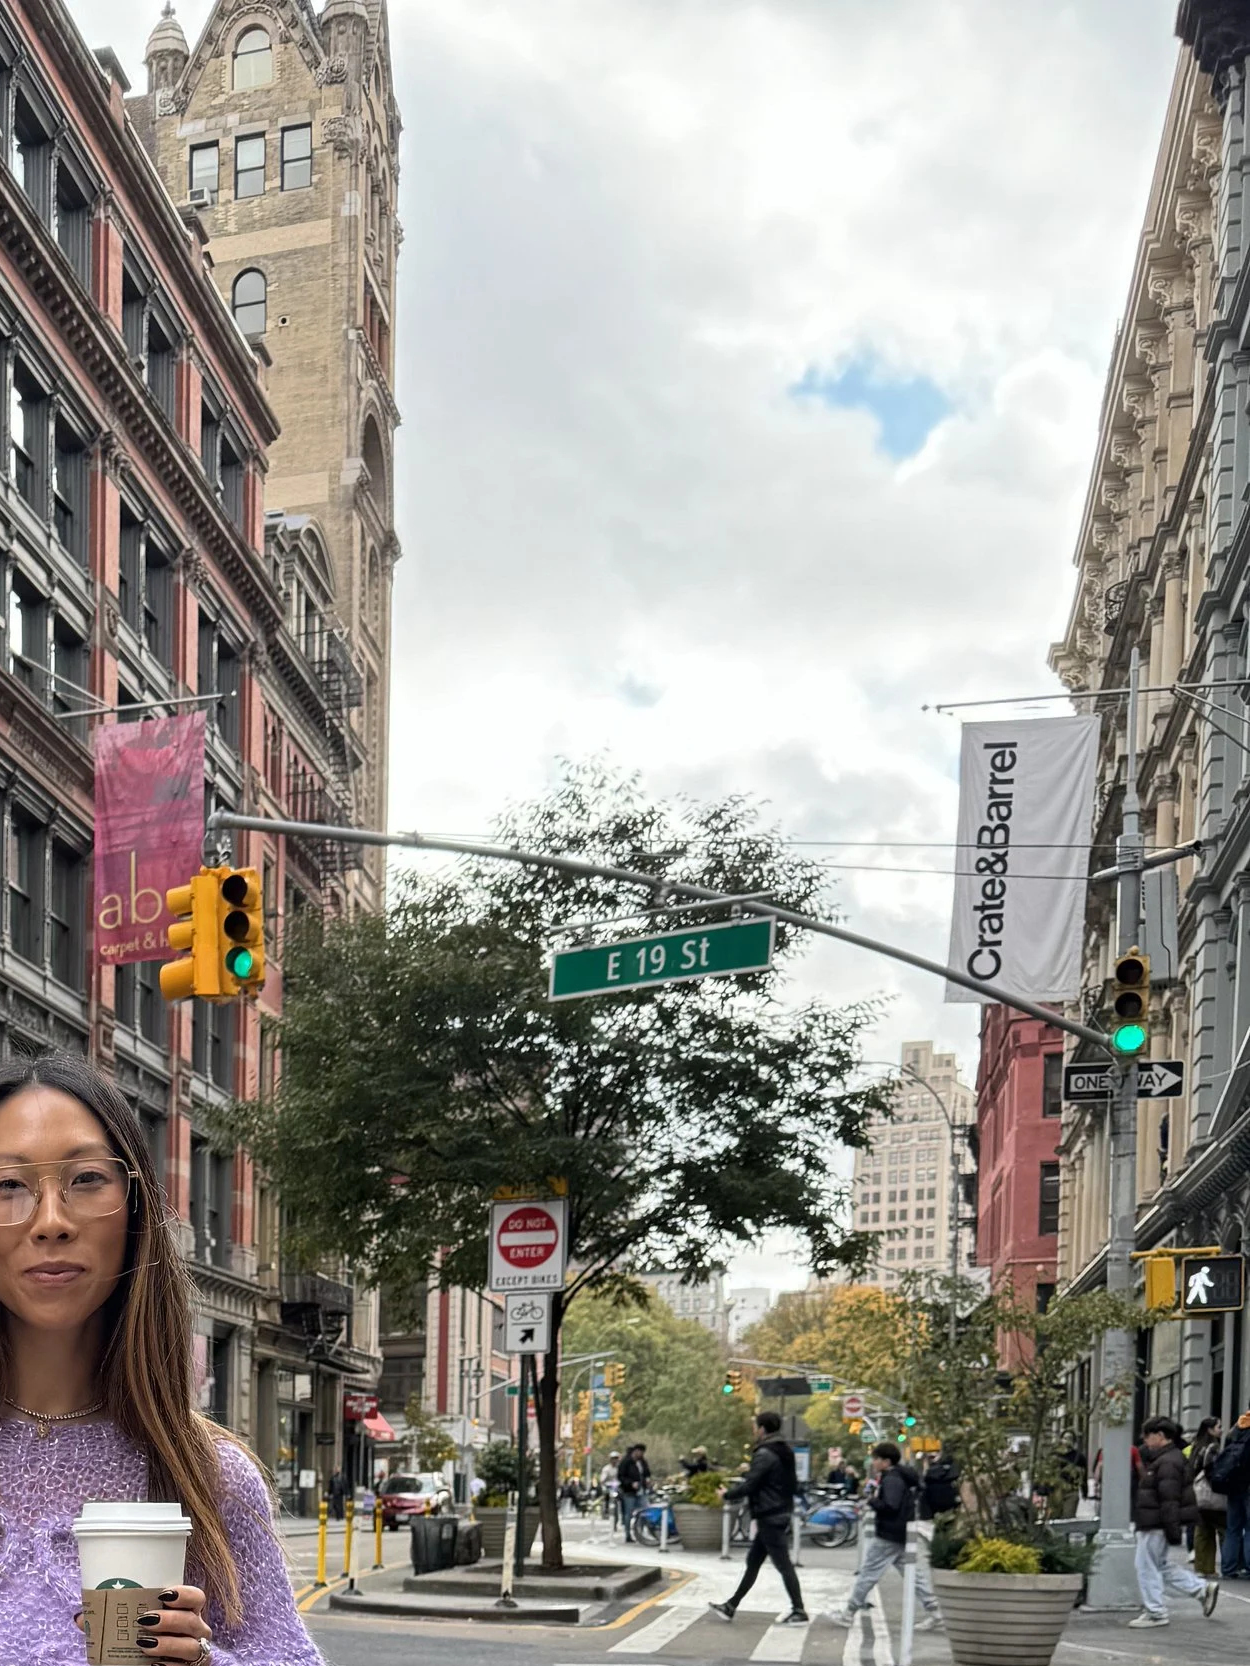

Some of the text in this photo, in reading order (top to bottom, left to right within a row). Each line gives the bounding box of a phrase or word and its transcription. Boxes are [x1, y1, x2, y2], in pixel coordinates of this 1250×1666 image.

[967, 742, 1018, 981] Crate&Barrel
[99, 850, 163, 929] ab
[100, 937, 139, 958] carpet
[143, 931, 157, 949] &
[607, 937, 710, 981] E 19 St
[1074, 1075, 1109, 1090] ONE
[508, 1218, 547, 1230] DO NOT
[510, 1247, 544, 1259] ENTER
[496, 1274, 558, 1286] EXCEPT BIKES
